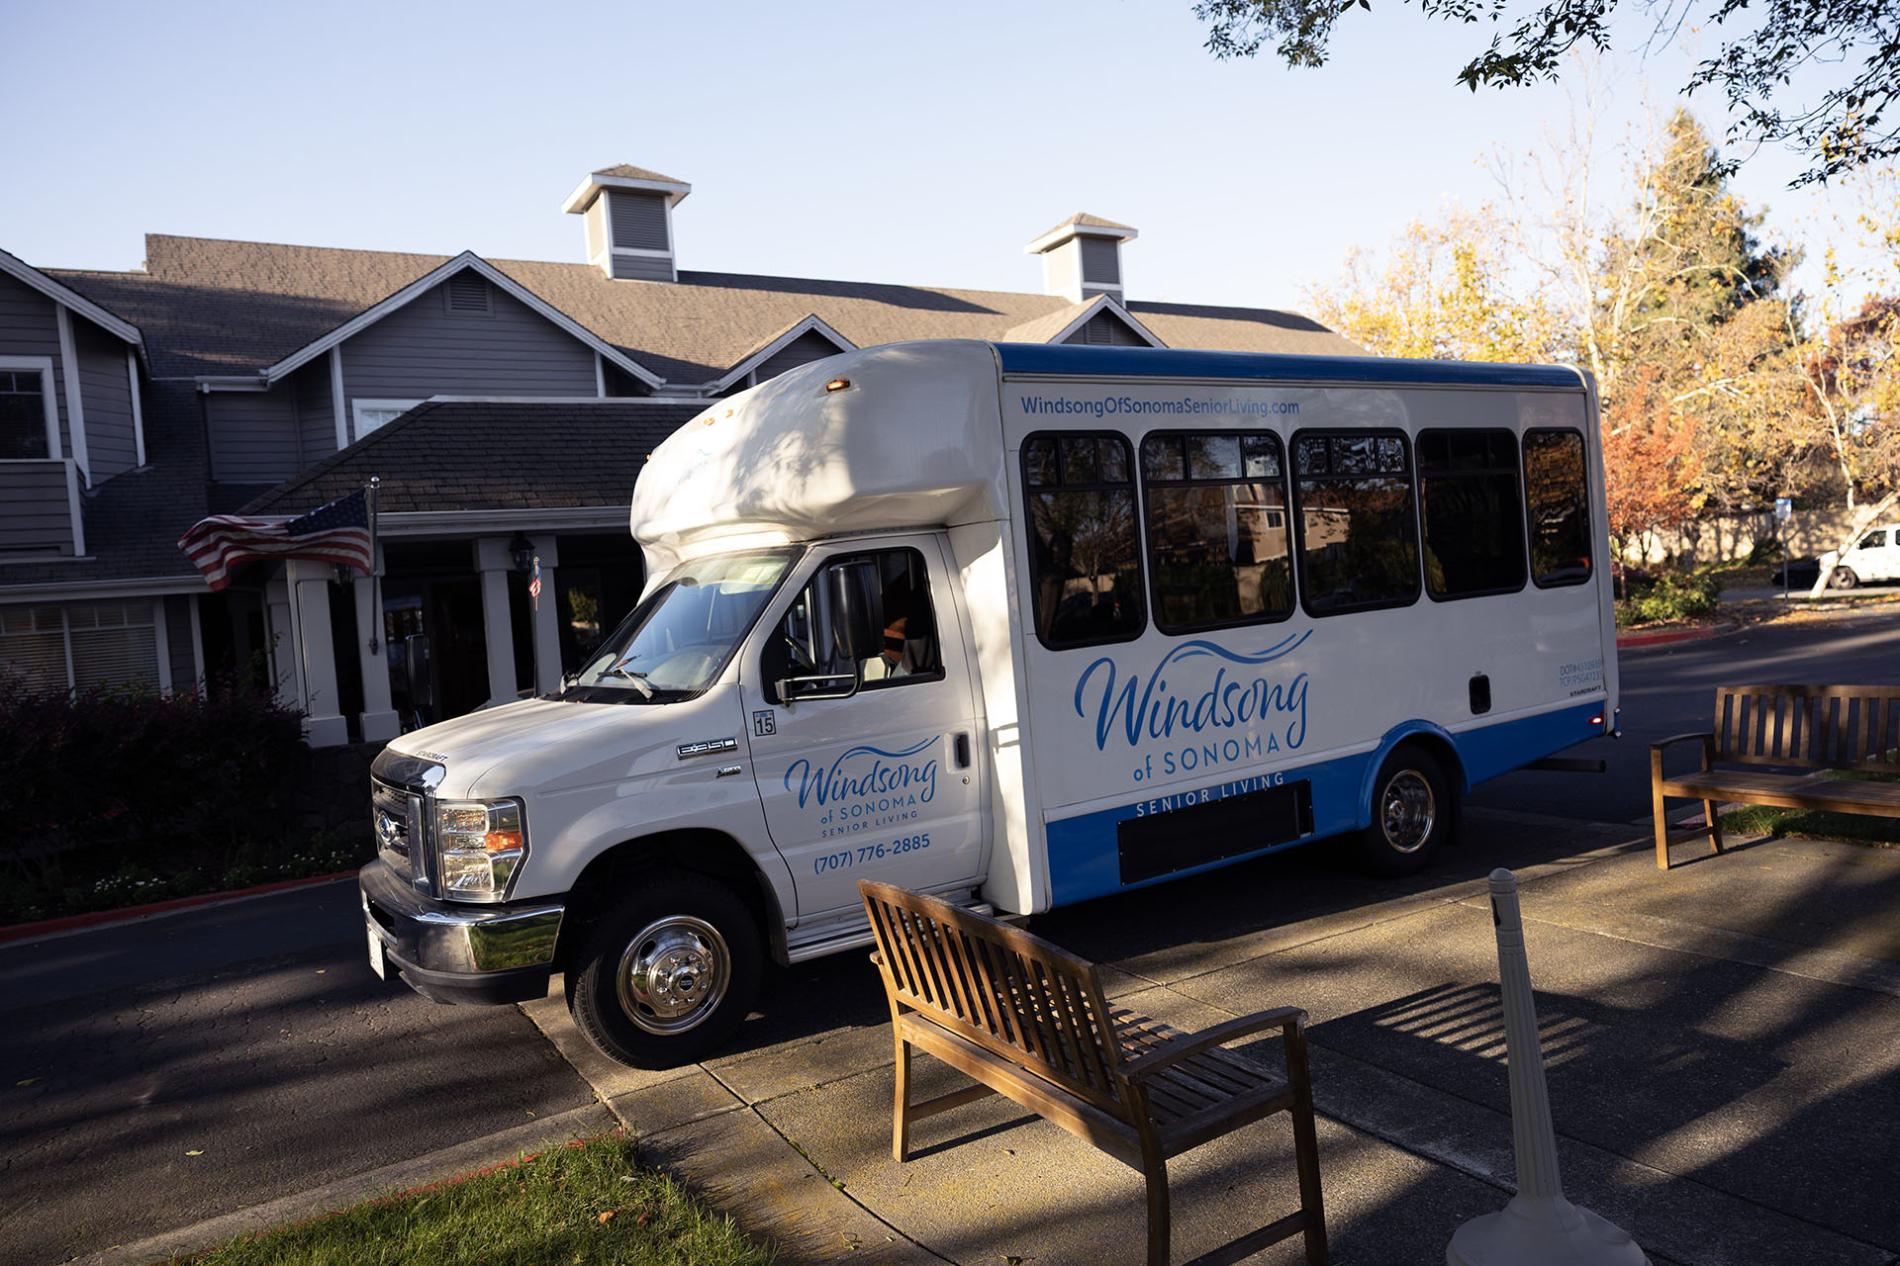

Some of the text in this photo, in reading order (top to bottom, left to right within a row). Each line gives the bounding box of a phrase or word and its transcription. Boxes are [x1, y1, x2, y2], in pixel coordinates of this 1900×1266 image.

[1021, 396, 1300, 418] WindsongOfSonomaSeniorLiving.com
[1074, 640, 1310, 752] Windsong
[756, 716, 774, 734] 15
[784, 745, 939, 809] Windsong
[1133, 732, 1280, 781] of SONOMA
[820, 794, 917, 824] of SONOMA
[1136, 772, 1285, 817] SENIOR LIVING
[822, 810, 918, 838] SENIOR LIVING
[814, 833, 931, 875] (707) 776-2885
